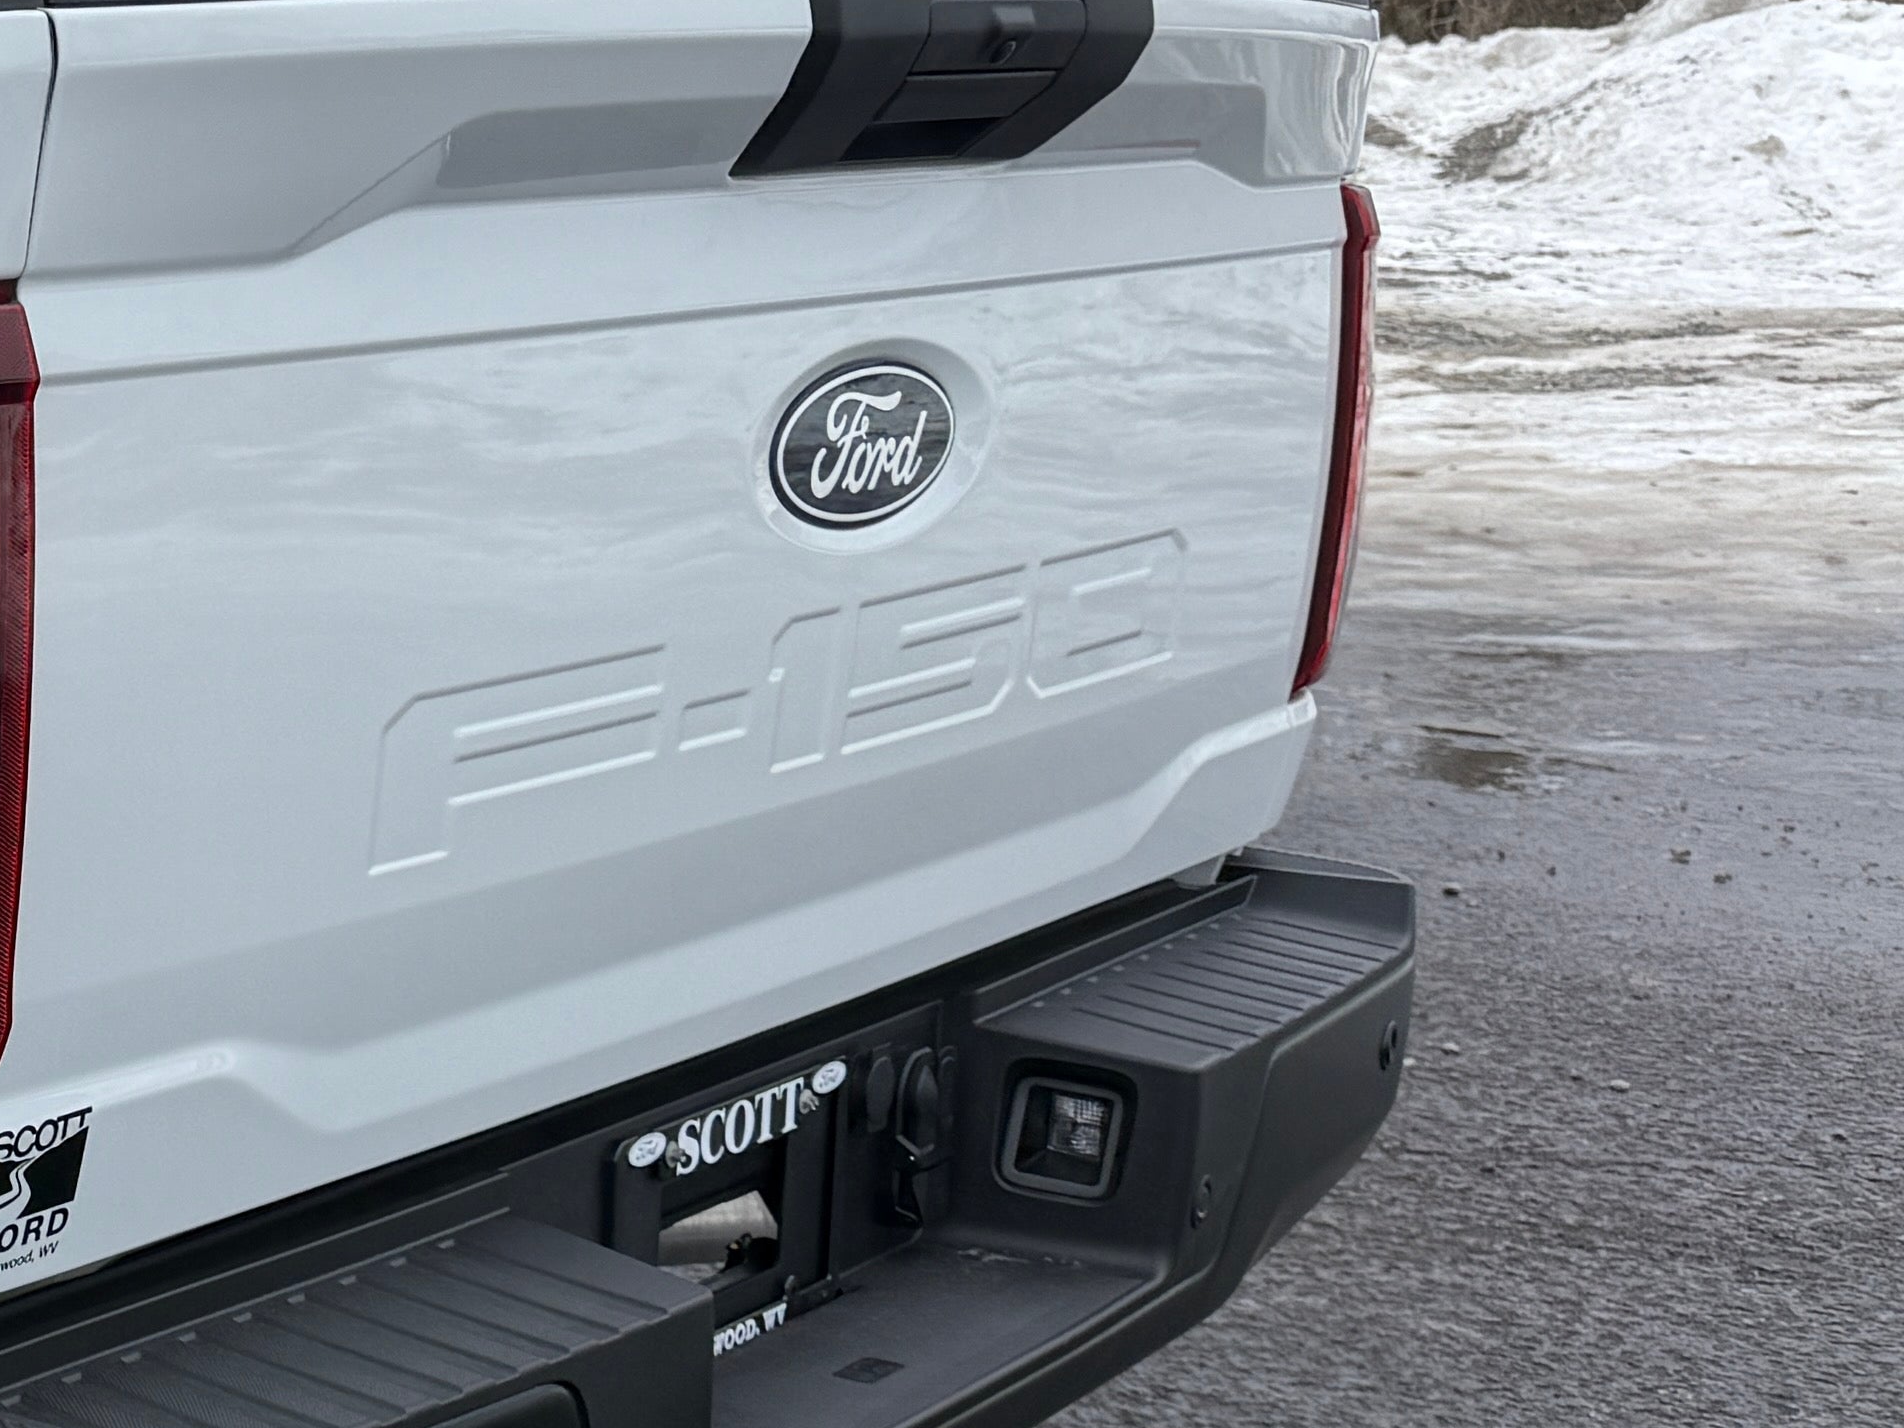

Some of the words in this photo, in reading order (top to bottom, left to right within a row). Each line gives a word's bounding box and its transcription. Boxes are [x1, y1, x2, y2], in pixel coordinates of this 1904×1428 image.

[810, 390, 928, 499] Ford
[367, 527, 1190, 876] F-150
[675, 1076, 805, 1177] SCOTT
[38, 1239, 60, 1259] WV
[762, 1302, 788, 1332] WV
